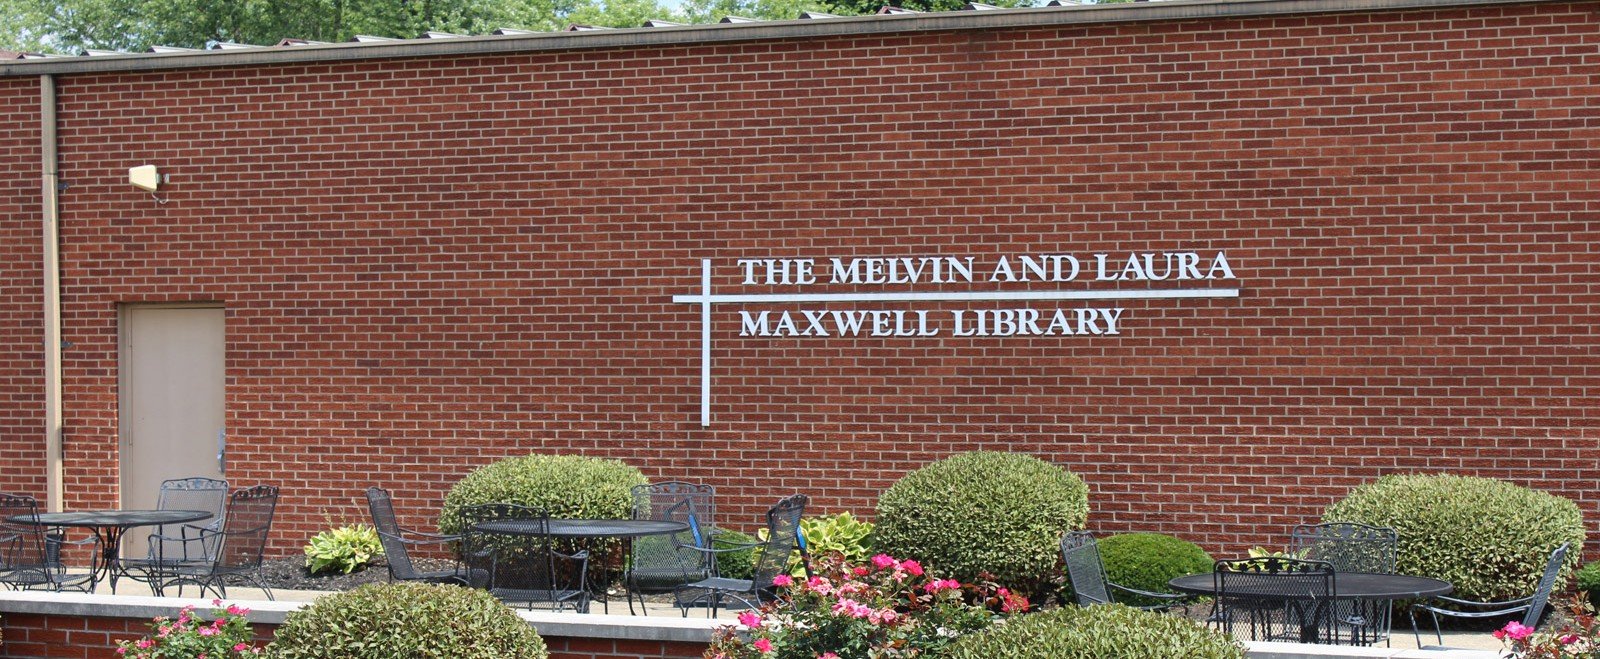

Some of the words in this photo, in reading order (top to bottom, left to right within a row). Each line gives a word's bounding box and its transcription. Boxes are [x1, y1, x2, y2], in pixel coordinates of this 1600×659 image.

[738, 258, 817, 285] THE
[829, 256, 975, 284] MELVIN
[989, 254, 1080, 282] AND
[1094, 251, 1236, 281] LAURA
[738, 309, 939, 337] MAXWELL
[951, 307, 1125, 337] LIBRARY
